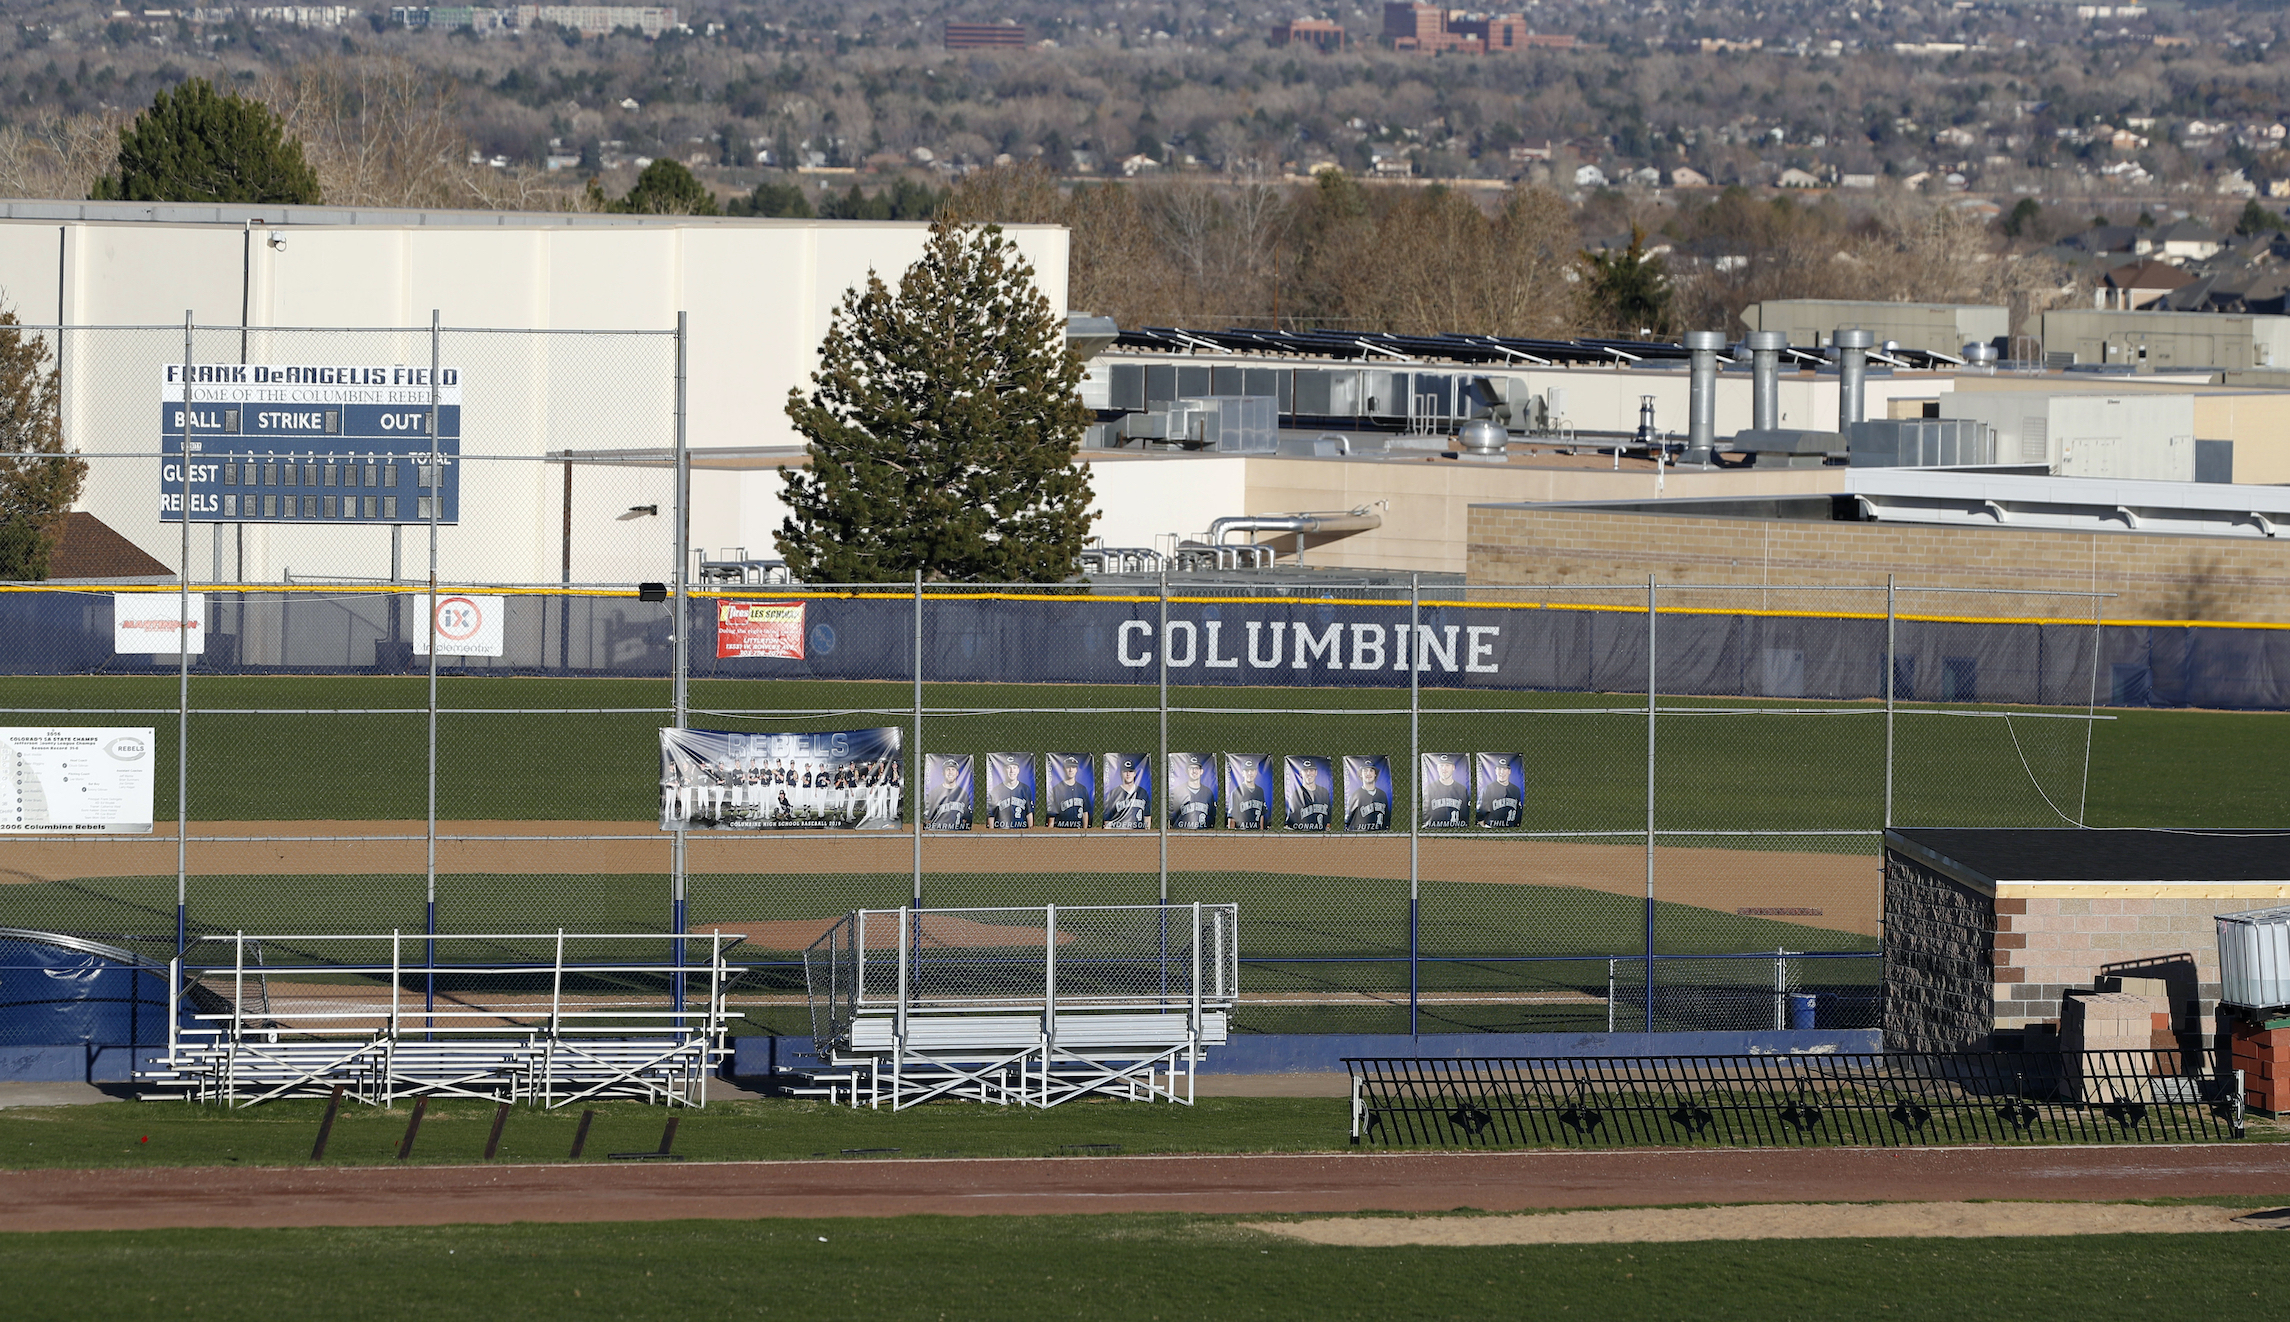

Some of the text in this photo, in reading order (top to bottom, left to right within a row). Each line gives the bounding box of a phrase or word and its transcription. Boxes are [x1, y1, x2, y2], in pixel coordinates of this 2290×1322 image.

[167, 366, 457, 386] FRANK DeANGELIS FIELD
[232, 388, 253, 401] OF
[257, 389, 287, 402] THE
[292, 389, 383, 403] COLUMBINE
[174, 411, 222, 428] BALL
[258, 412, 322, 430] STRIKE
[380, 413, 422, 430] OUT
[163, 464, 219, 483] GUEST
[750, 609, 764, 618] LES
[1117, 619, 1500, 673] COLUMBINE
[728, 732, 850, 758] REBELS
[1014, 806, 1022, 819] 2
[1135, 808, 1142, 822] 4
[994, 820, 1028, 828] COLLINS
[1057, 820, 1082, 828] MAVIS
[1240, 821, 1258, 829] ALVA
[1292, 822, 1324, 830] CONRAD
